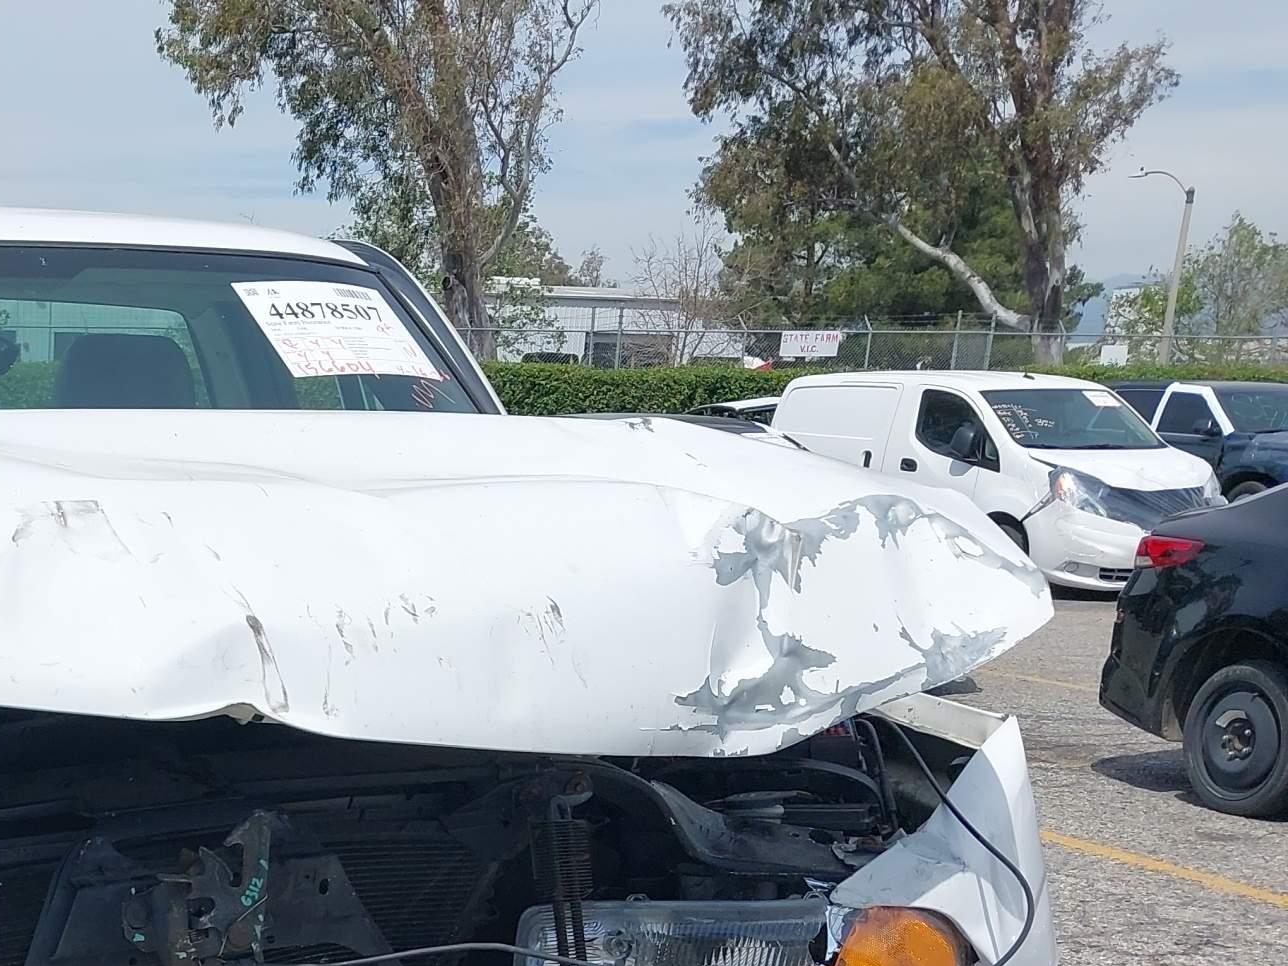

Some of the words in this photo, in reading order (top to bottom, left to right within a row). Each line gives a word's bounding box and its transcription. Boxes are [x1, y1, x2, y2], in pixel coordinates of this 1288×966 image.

[269, 301, 382, 322] 44878507
[783, 333, 810, 343] STATE
[815, 333, 838, 343] FARM
